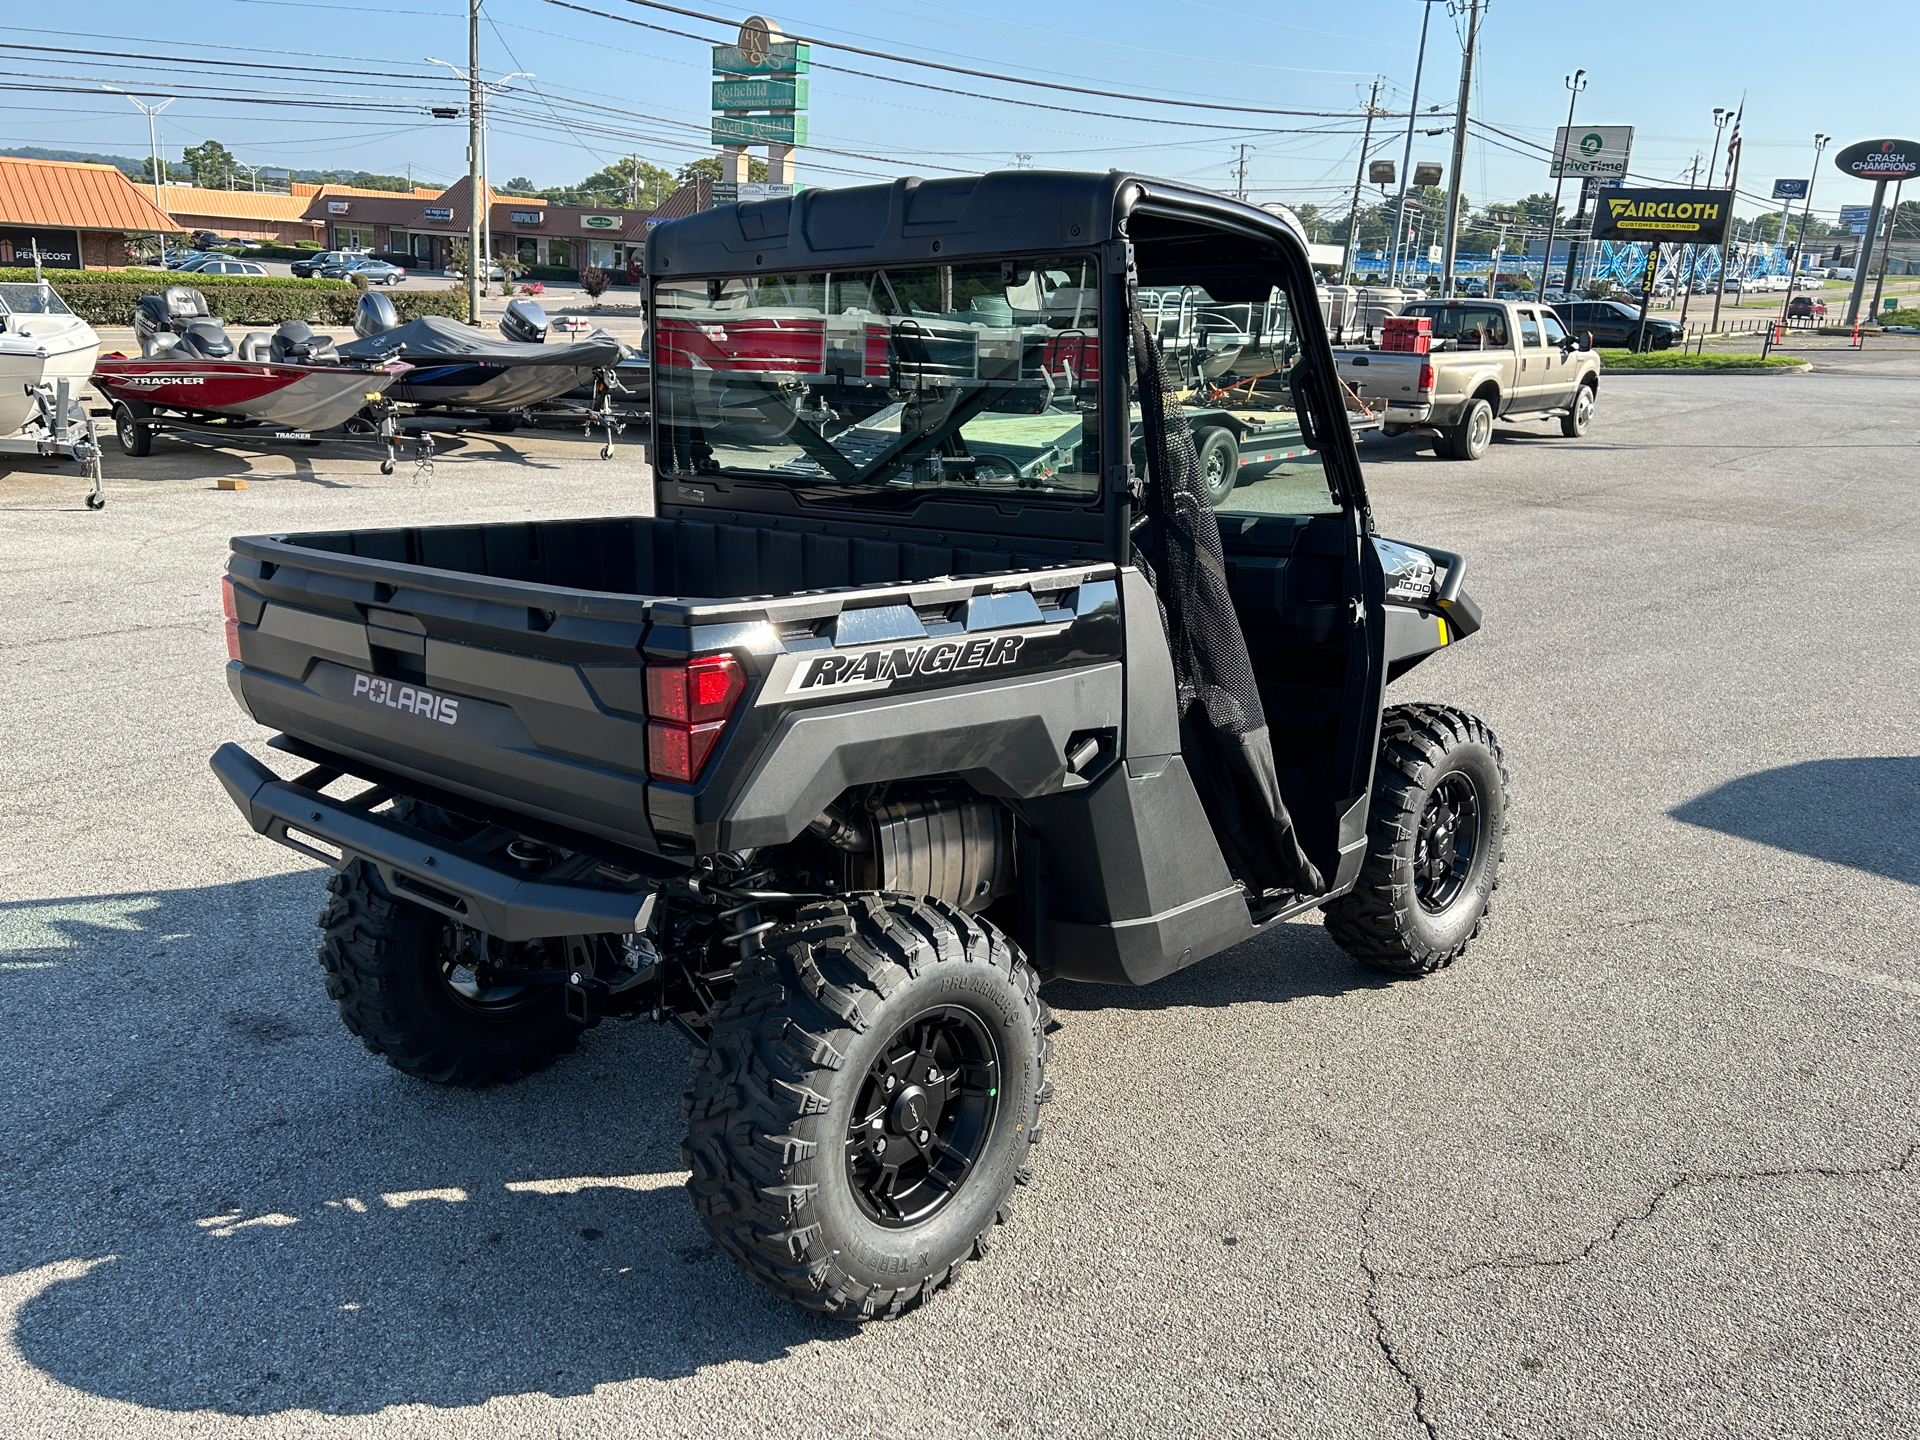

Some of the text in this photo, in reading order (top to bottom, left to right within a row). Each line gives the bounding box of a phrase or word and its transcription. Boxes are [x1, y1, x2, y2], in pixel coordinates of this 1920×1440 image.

[715, 83, 767, 99] Rothchild
[734, 98, 793, 107] CONFERENCE CENTER
[714, 118, 792, 133] Event Rentals
[1866, 153, 1906, 162] CRASH
[1552, 160, 1623, 171] DriveTime
[1851, 161, 1917, 171] CHAMPIONS
[768, 184, 790, 192] Express
[1608, 199, 1719, 219] FAIRCLOTH
[1620, 221, 1653, 229] CUSTOMS
[1642, 250, 1658, 292] 8812
[133, 377, 205, 386] TRACKER
[275, 432, 311, 440] TRACKER
[1399, 580, 1431, 594] 1000
[799, 634, 1025, 689] RANGER
[353, 673, 459, 725] POLARIS
[941, 976, 1013, 1015] PRO ARMOR
[843, 1229, 930, 1276] X-TERRAIN
